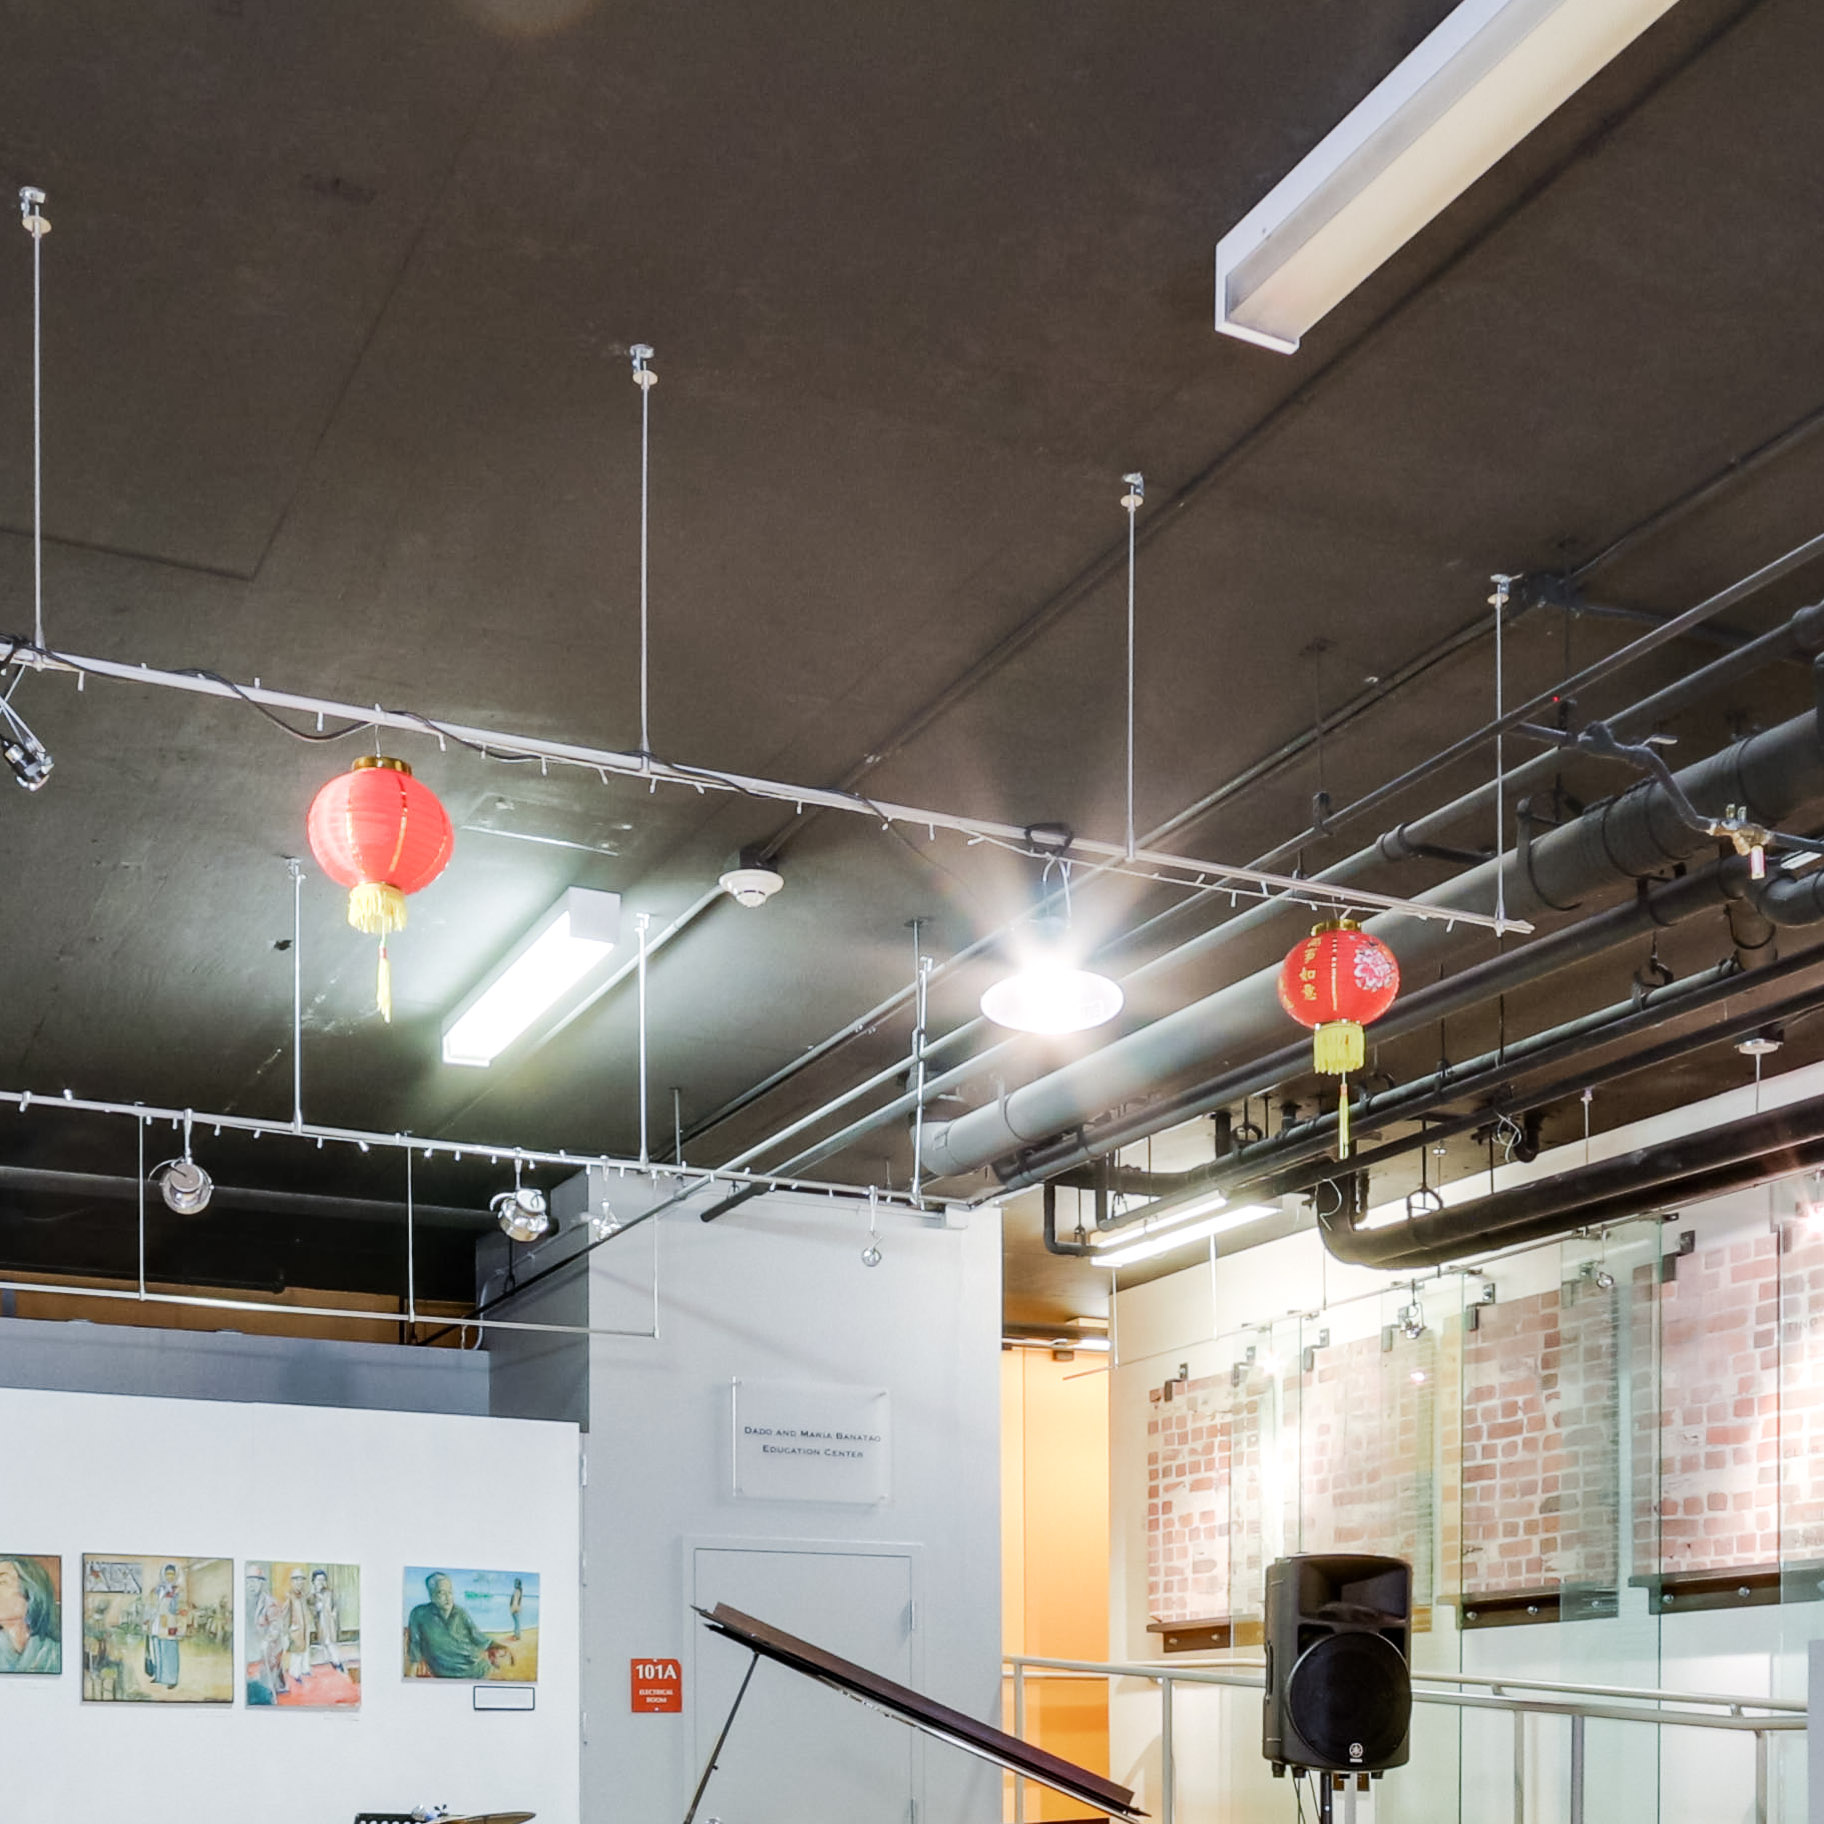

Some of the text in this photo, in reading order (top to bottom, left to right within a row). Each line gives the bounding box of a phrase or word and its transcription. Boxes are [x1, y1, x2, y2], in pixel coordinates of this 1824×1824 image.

[744, 1426, 773, 1436] DADO
[776, 1429, 796, 1437] AND
[800, 1430, 832, 1439] MARIA
[762, 1444, 864, 1458] EDUCATION CENTER
[635, 1663, 677, 1680] 101A
